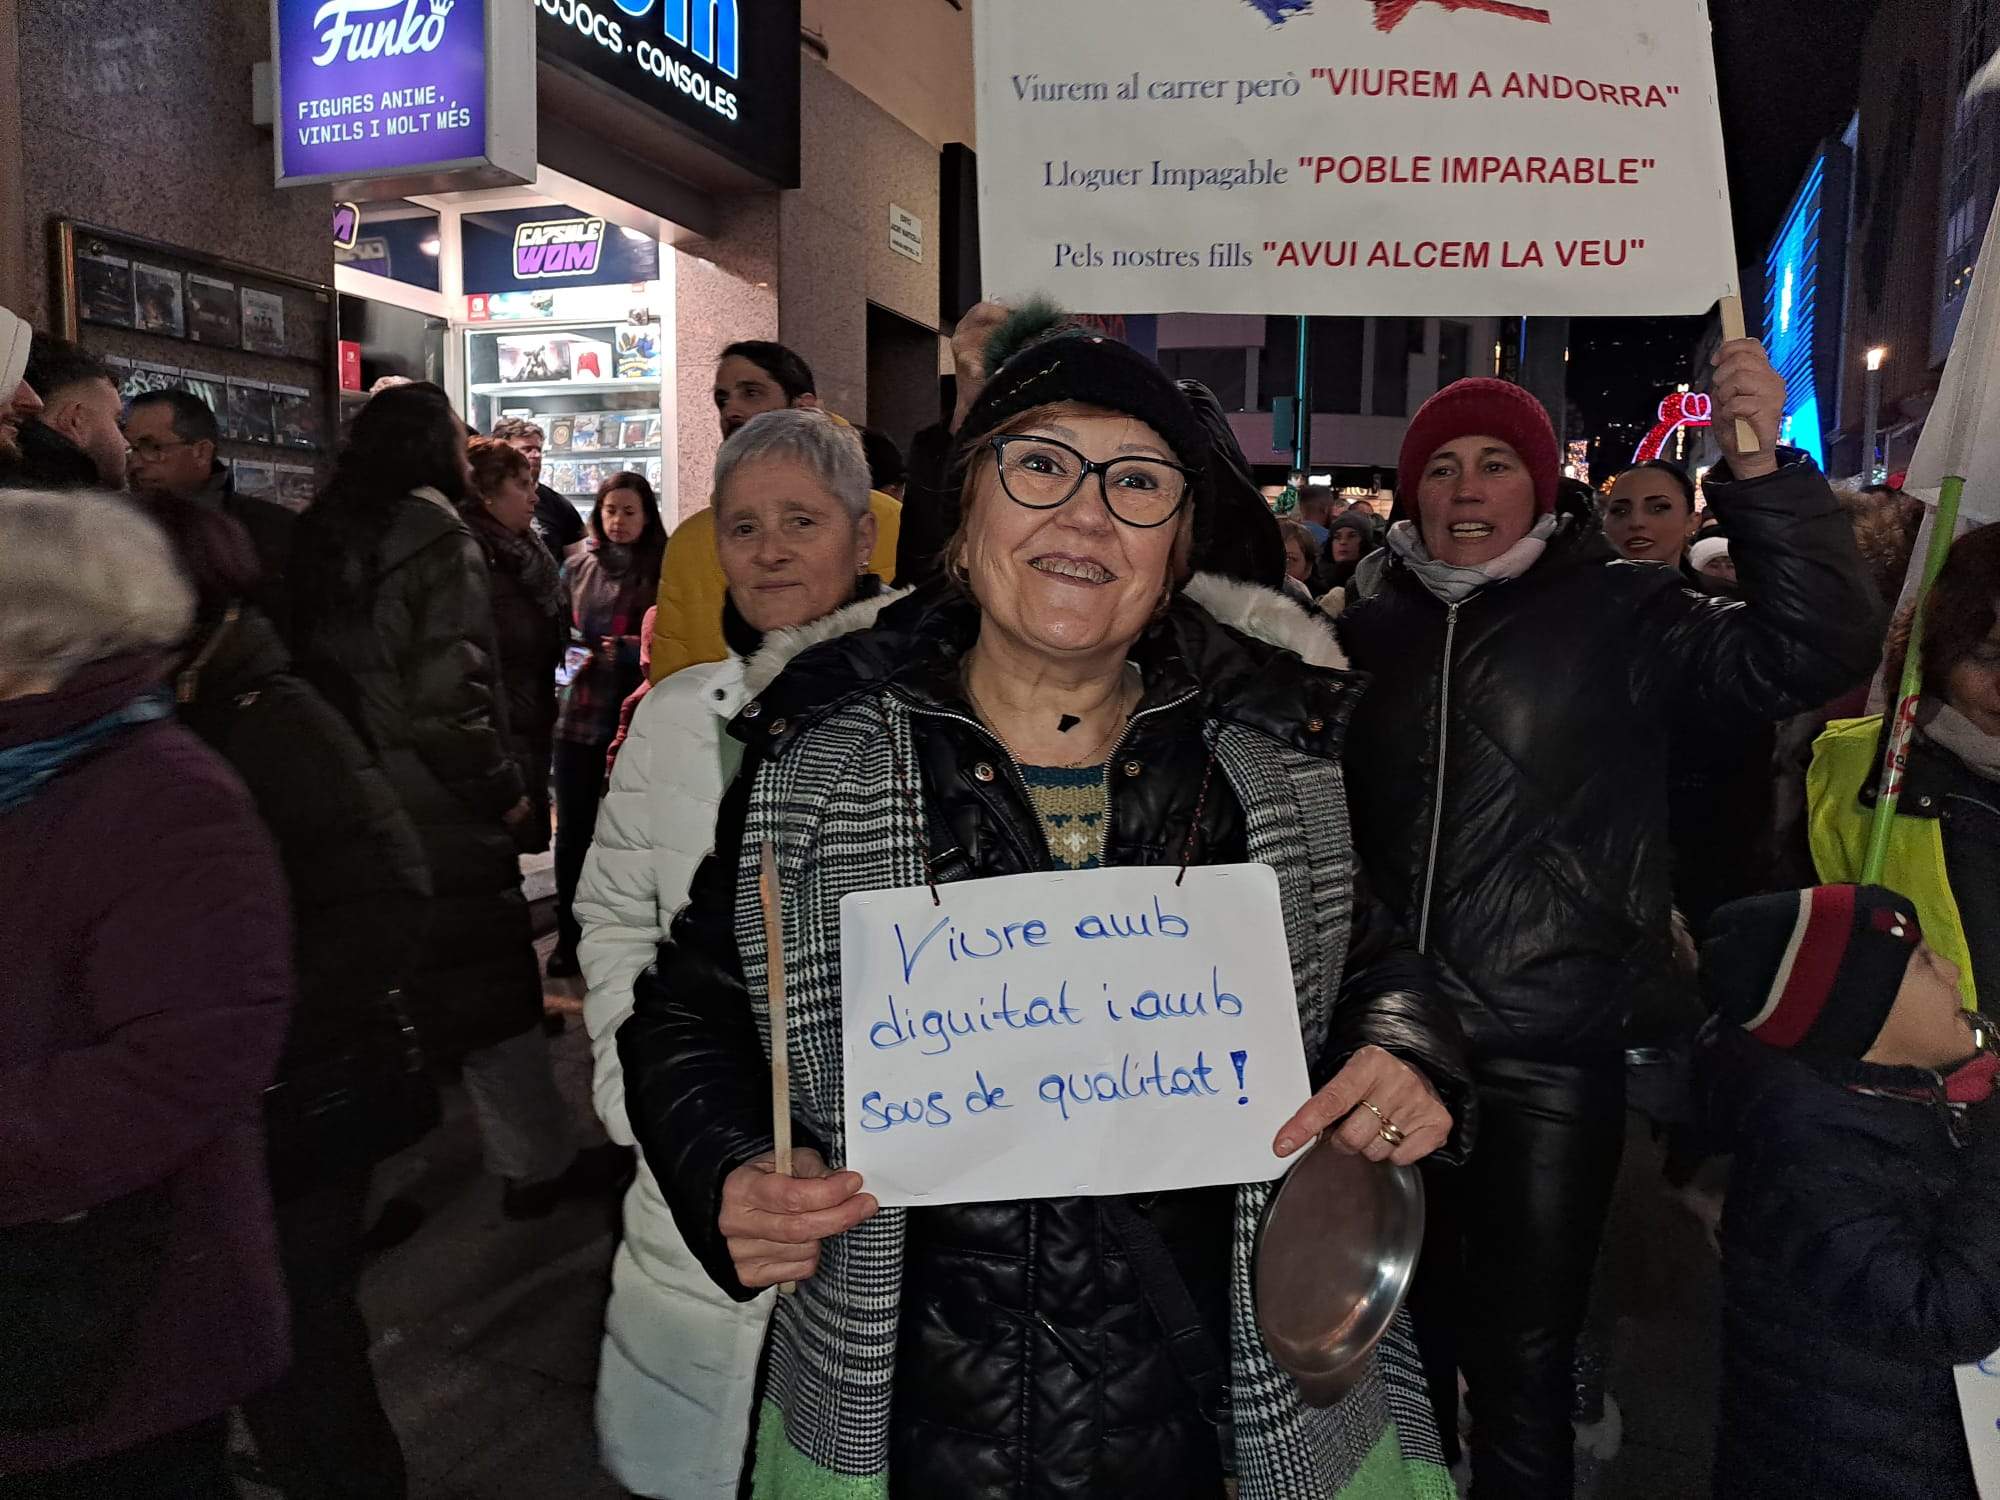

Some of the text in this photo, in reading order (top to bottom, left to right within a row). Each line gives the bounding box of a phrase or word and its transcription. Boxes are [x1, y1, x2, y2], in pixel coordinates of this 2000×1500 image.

[312, 0, 446, 67] Funko
[635, 40, 738, 121] CONSOLES
[1010, 67, 1680, 108] Viurem al carrer però "VIUREM A ANDORRA"
[298, 101, 471, 146] VINILS I MOLT MÉS
[299, 94, 374, 121] FIGURES
[1044, 155, 1655, 191] Lloguer Impagable "POBLE IMPARABLE"
[1054, 239, 1645, 268] Pels nostres fills "AVUI ALCEM LA VEU"
[965, 1070, 1014, 1112] de
